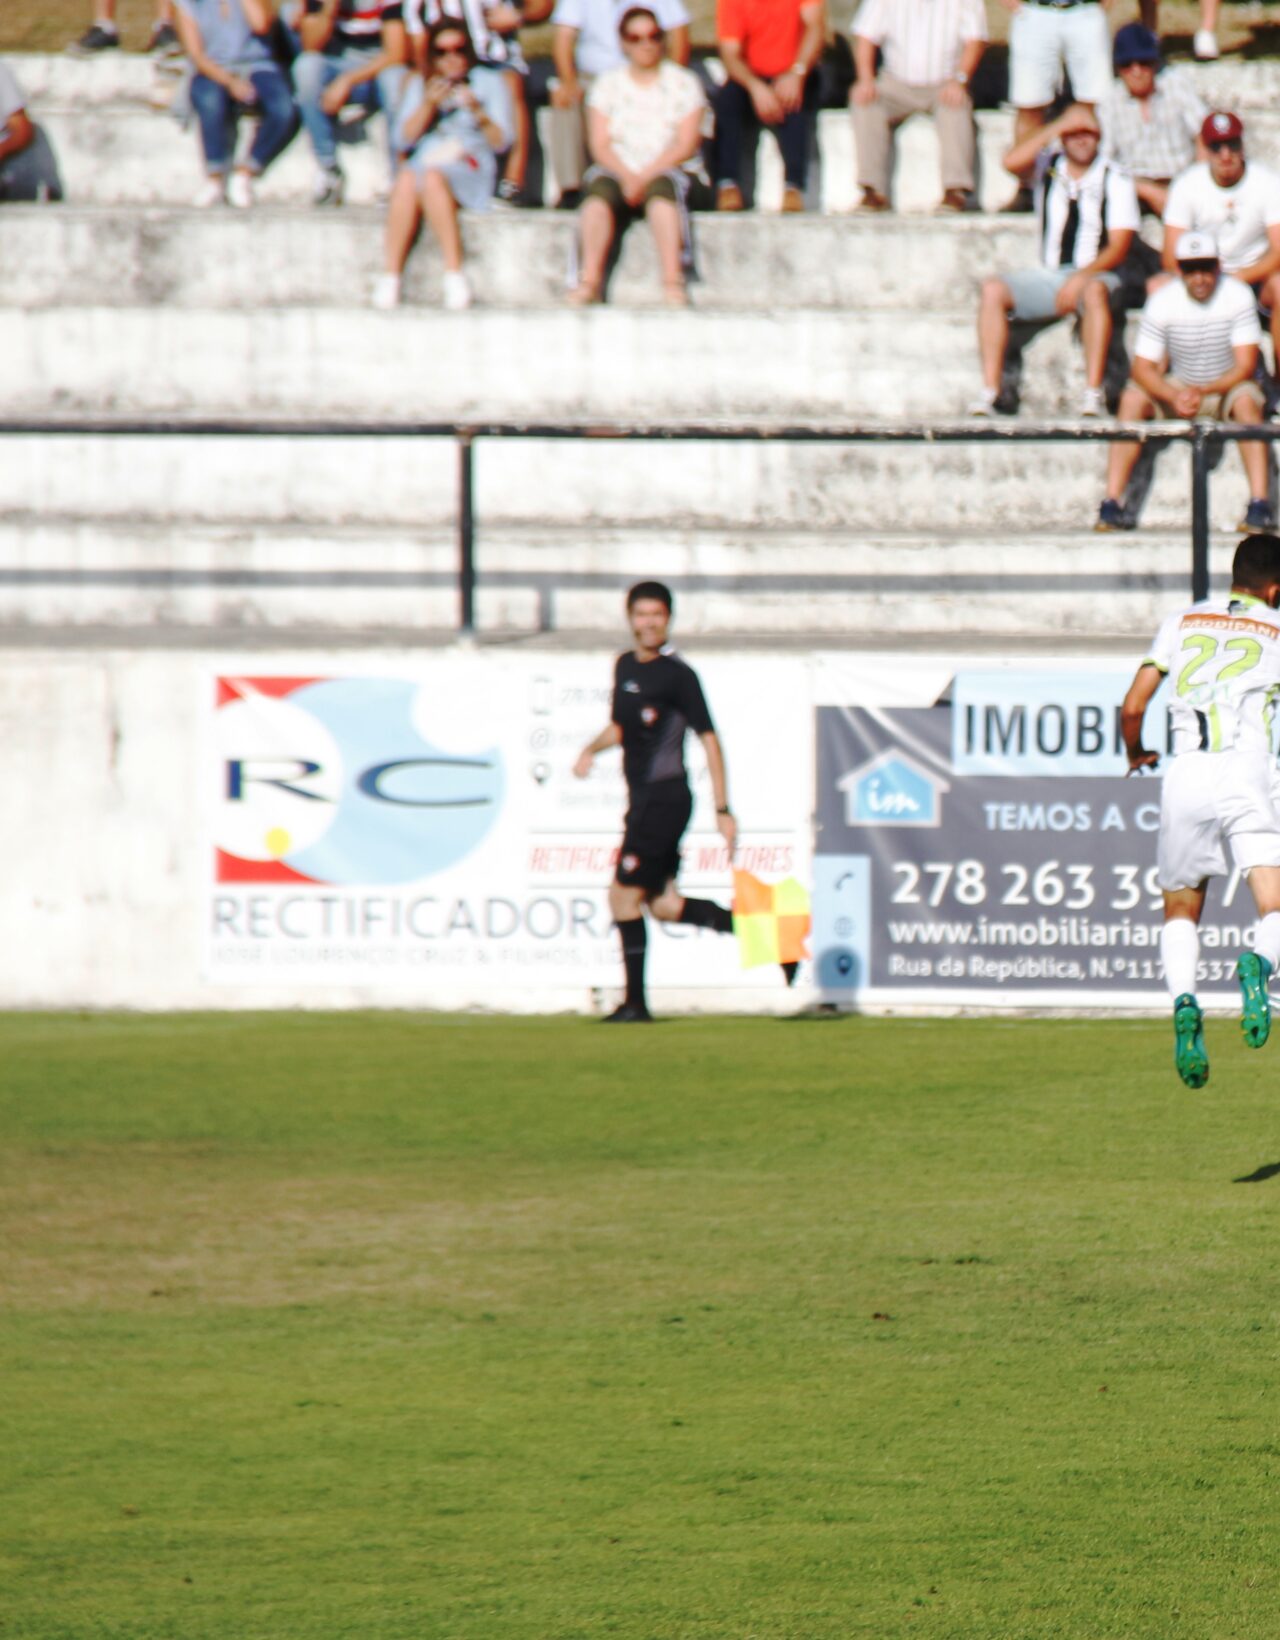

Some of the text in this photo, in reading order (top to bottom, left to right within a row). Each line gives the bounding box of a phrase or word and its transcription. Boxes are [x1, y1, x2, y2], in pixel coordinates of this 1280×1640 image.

[1176, 634, 1263, 697] 22
[983, 803, 1092, 832] TEMOS
[1101, 804, 1127, 831] A
[891, 859, 986, 907] 278
[1001, 860, 1096, 909] 263
[1110, 865, 1167, 911] 39
[888, 955, 932, 976] Rua
[936, 955, 966, 976] da
[969, 954, 1087, 980] República,
